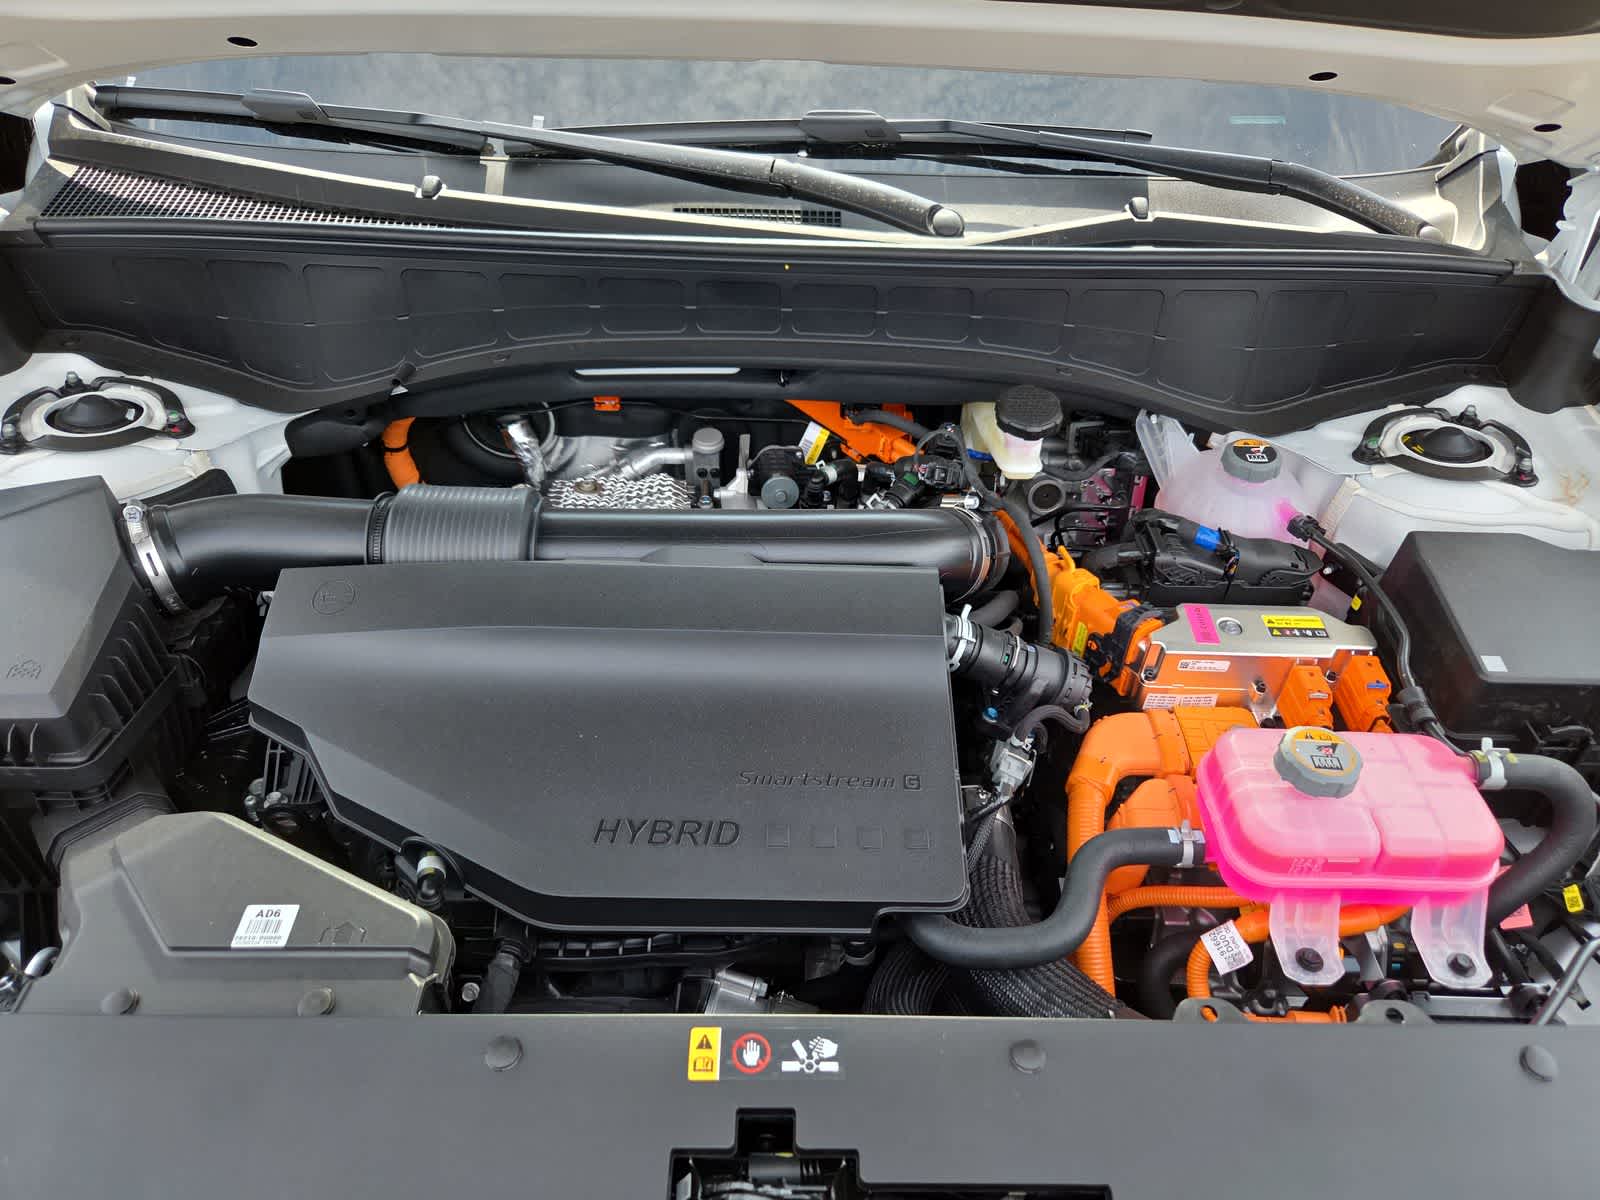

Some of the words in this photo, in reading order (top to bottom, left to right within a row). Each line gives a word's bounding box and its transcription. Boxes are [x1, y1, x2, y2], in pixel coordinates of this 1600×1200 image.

[738, 770, 897, 789] Smartstream
[903, 774, 921, 791] G
[592, 817, 742, 846] HYBRID
[255, 908, 282, 919] AD6
